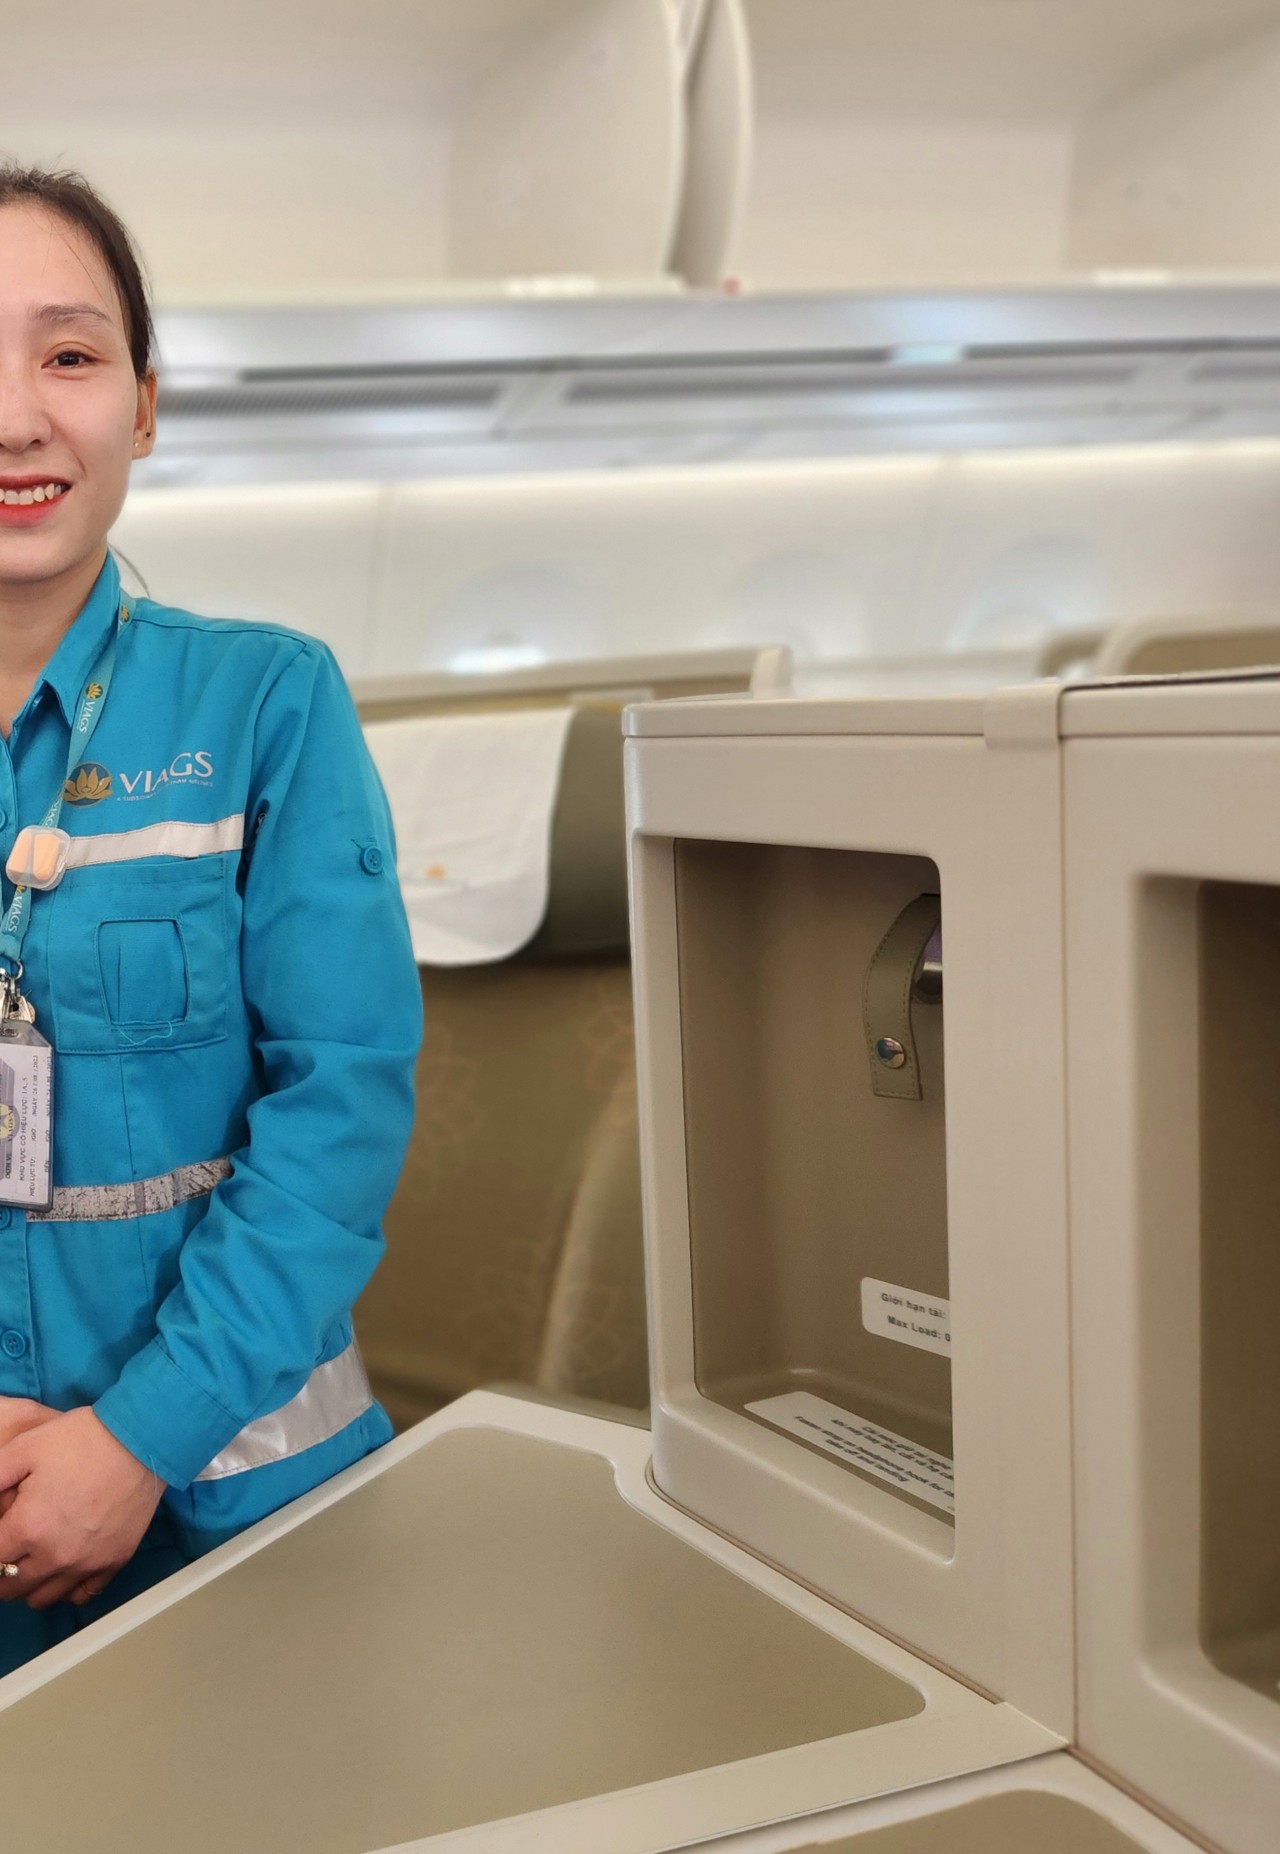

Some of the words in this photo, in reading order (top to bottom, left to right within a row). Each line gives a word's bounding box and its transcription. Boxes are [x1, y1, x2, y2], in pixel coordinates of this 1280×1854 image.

[79, 701, 96, 734] VIAGS
[119, 751, 214, 794] VIAGS
[8, 896, 23, 933] VIAGS
[20, 1117, 29, 1134] HIỆU
[19, 1148, 27, 1163] VỰC
[881, 1292, 903, 1306] Giới
[906, 1300, 925, 1313] hạn
[929, 1307, 946, 1319] tải:
[887, 1315, 908, 1328] Max
[911, 1322, 941, 1339] Load:
[874, 1463, 910, 1483] landing
[929, 1481, 945, 1491] for
